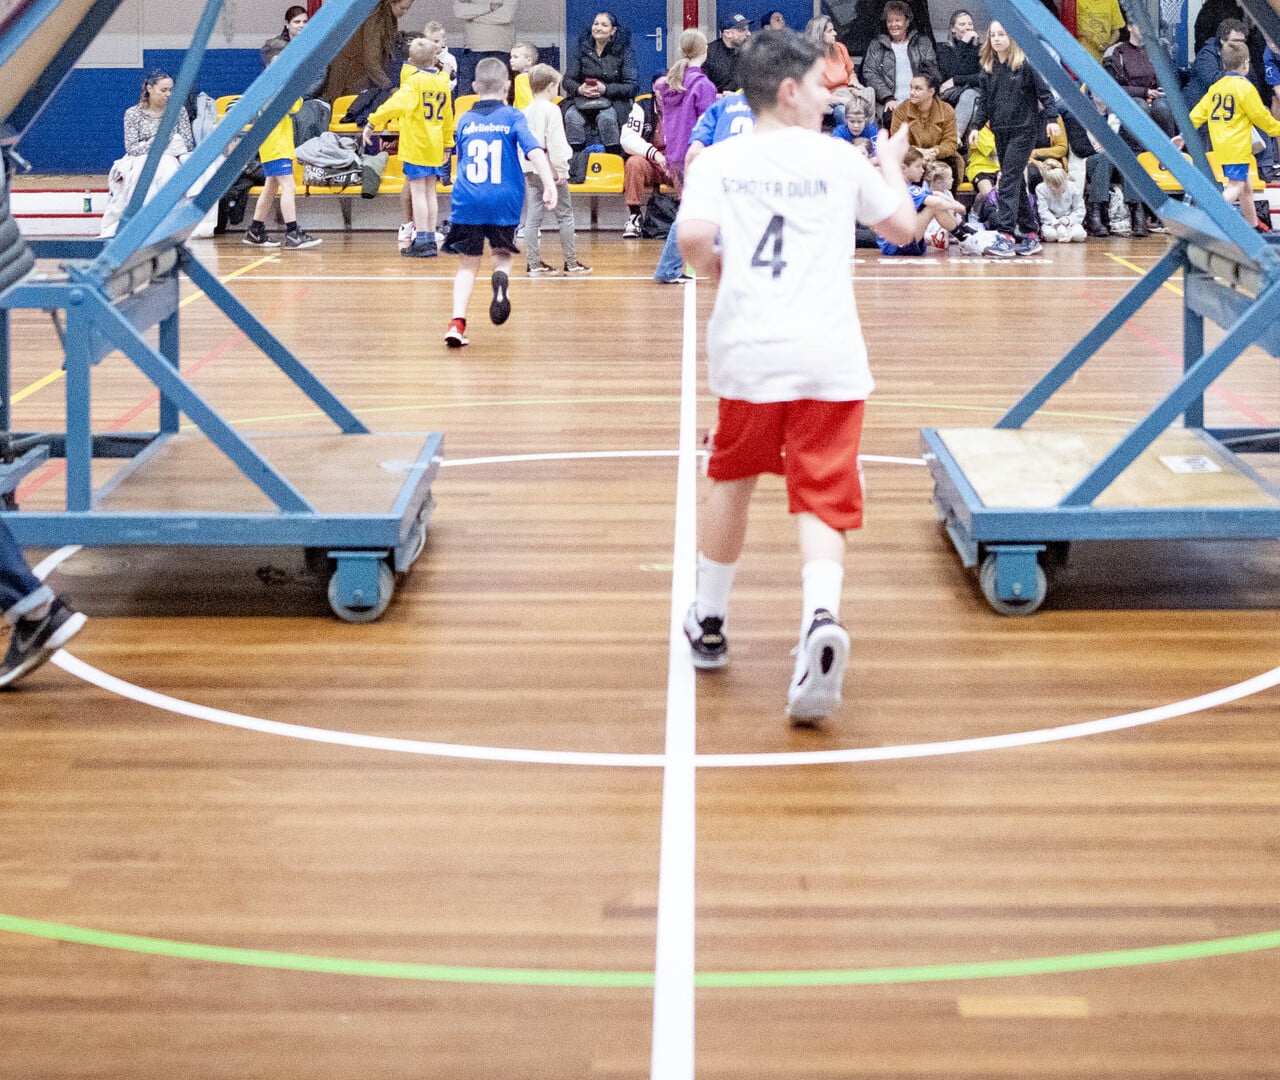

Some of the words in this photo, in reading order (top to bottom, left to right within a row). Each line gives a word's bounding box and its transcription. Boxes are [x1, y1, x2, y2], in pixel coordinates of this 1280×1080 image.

[423, 91, 447, 121] 52
[1210, 93, 1235, 122] 29
[466, 139, 503, 184] 31
[750, 215, 787, 279] 4
